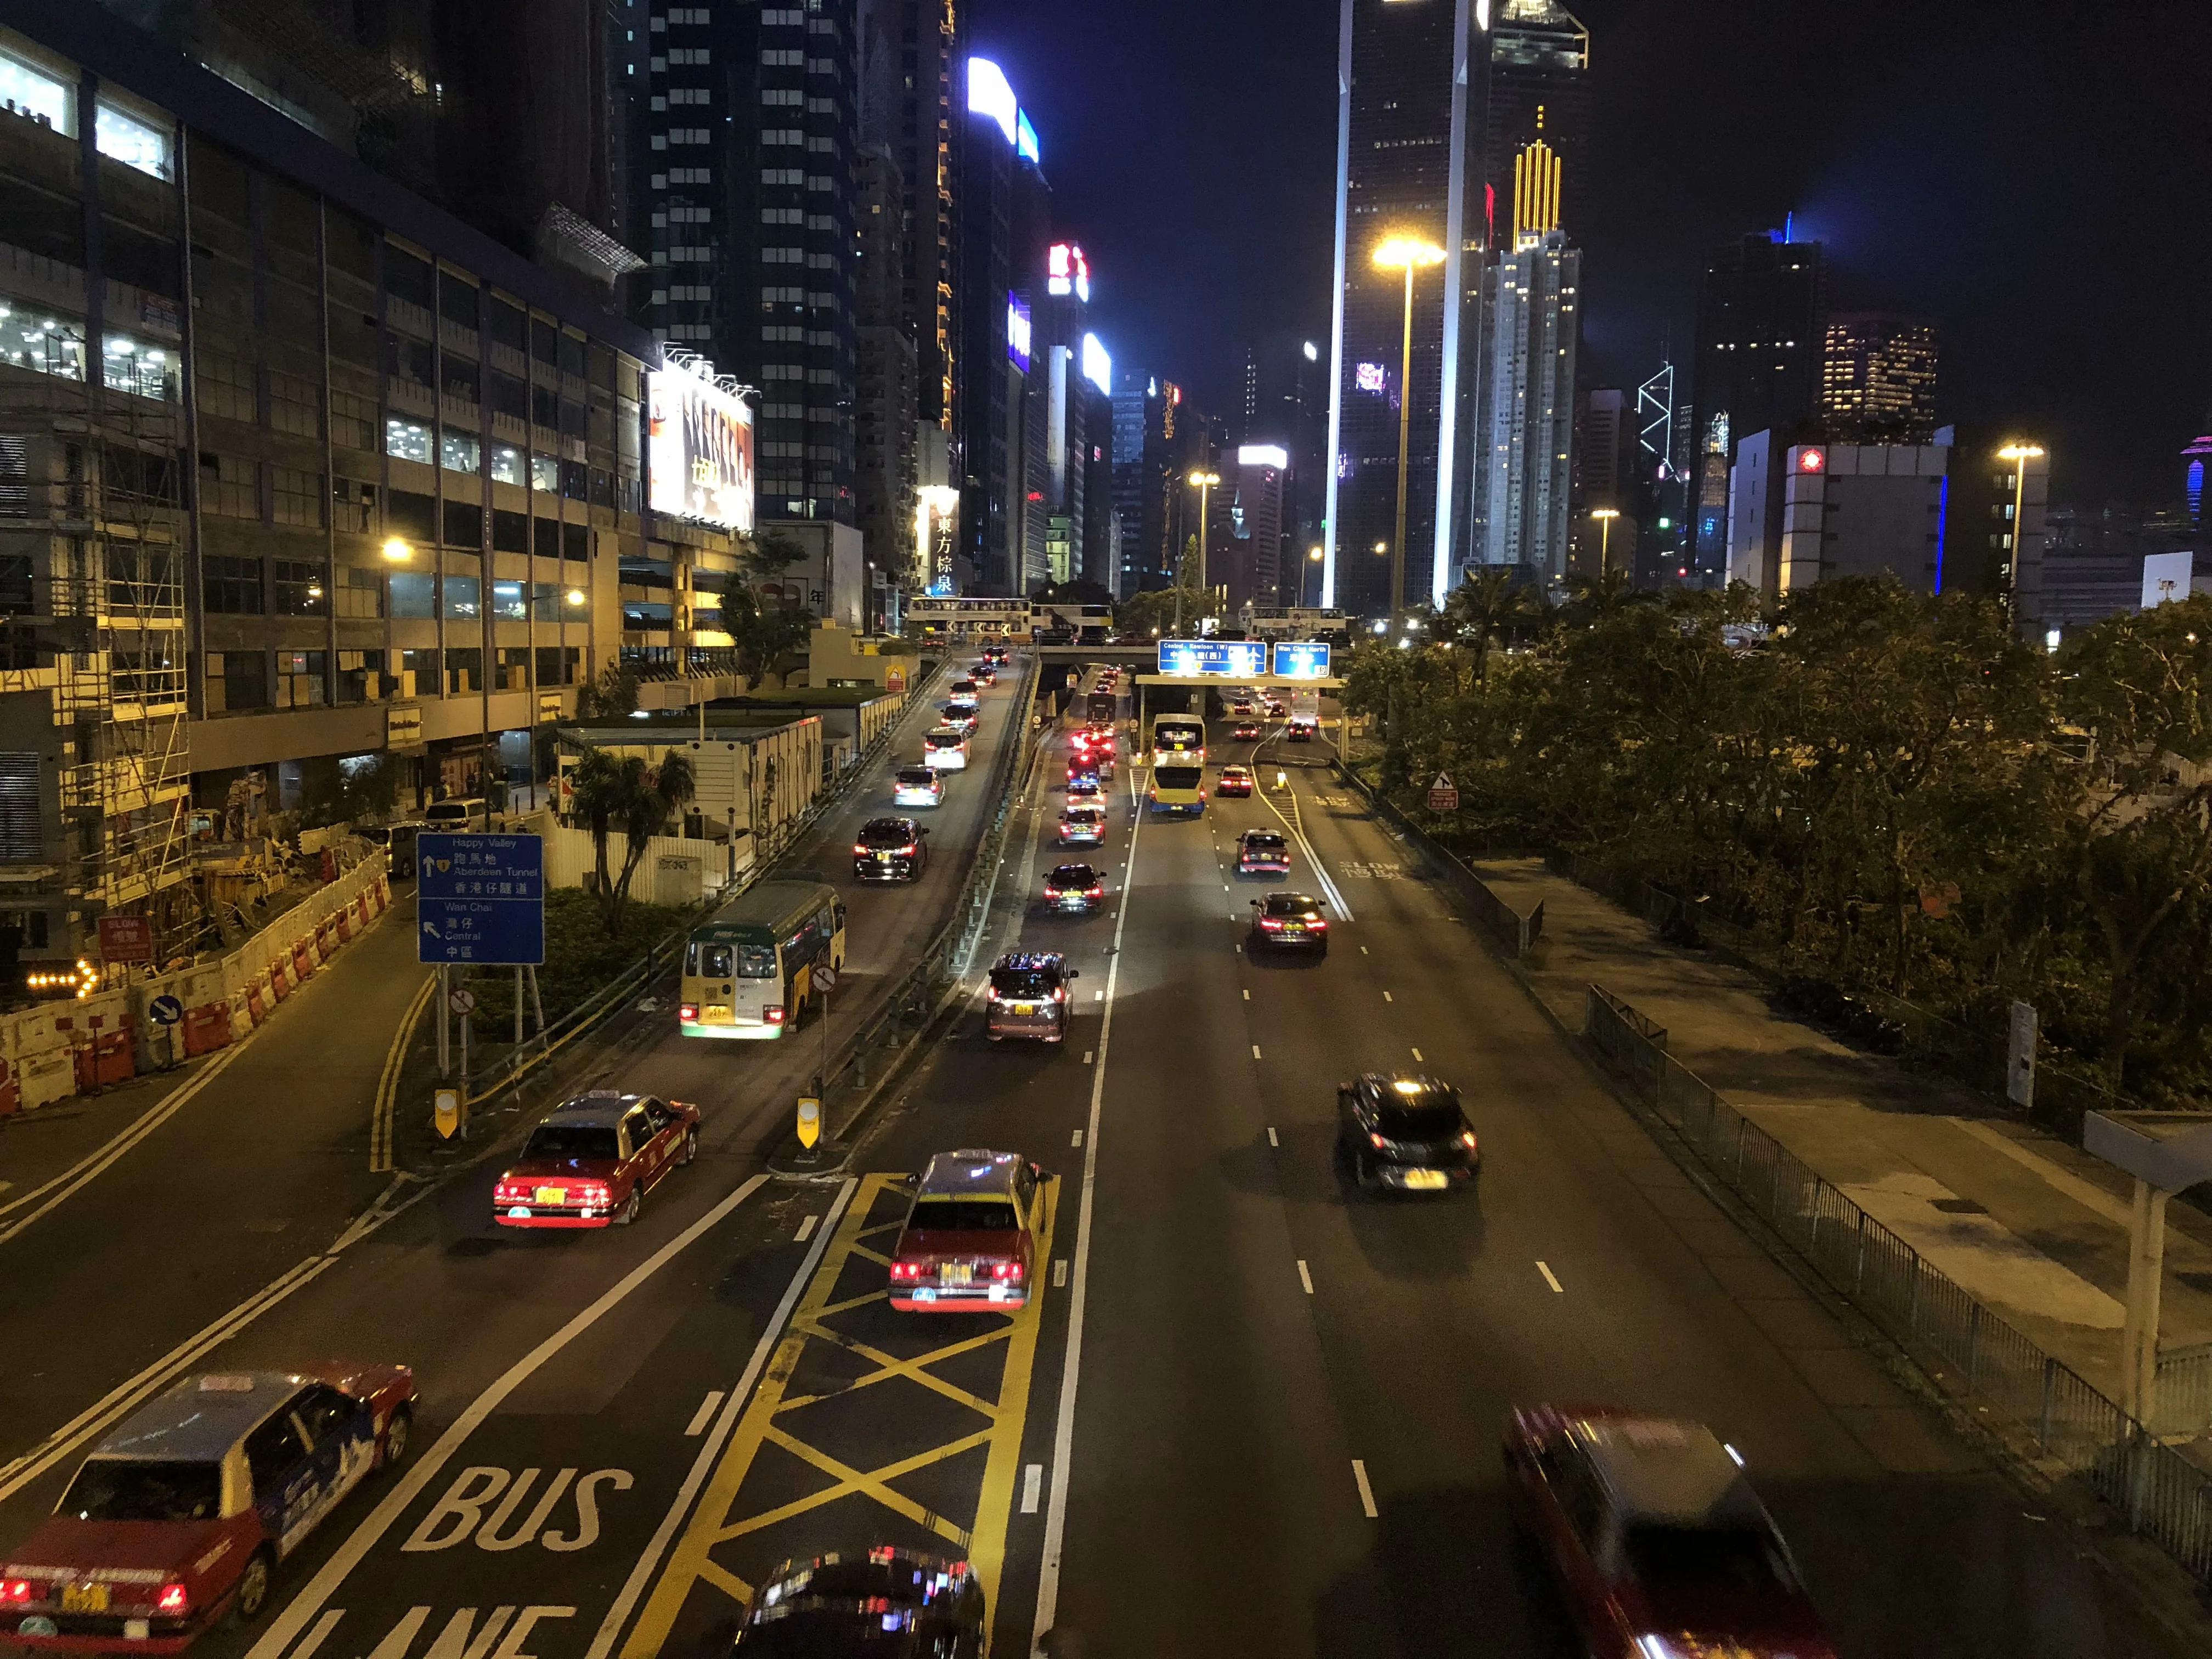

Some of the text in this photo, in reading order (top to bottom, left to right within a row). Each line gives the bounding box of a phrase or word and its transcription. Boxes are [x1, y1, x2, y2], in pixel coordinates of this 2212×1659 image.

[936, 517, 952, 592] 東方棕泉
[453, 838, 517, 849] Happy Valley
[454, 853, 496, 865] 跑馬地
[1339, 861, 1400, 870] SLOW
[453, 867, 538, 877] Aberdeen Tunnel
[455, 882, 527, 894] 香港仔隧道
[444, 902, 492, 912] Wan Chai
[445, 917, 473, 929] 灣仔
[445, 932, 481, 940] Central
[447, 946, 473, 958] 中區
[400, 1465, 635, 1553] BUS
